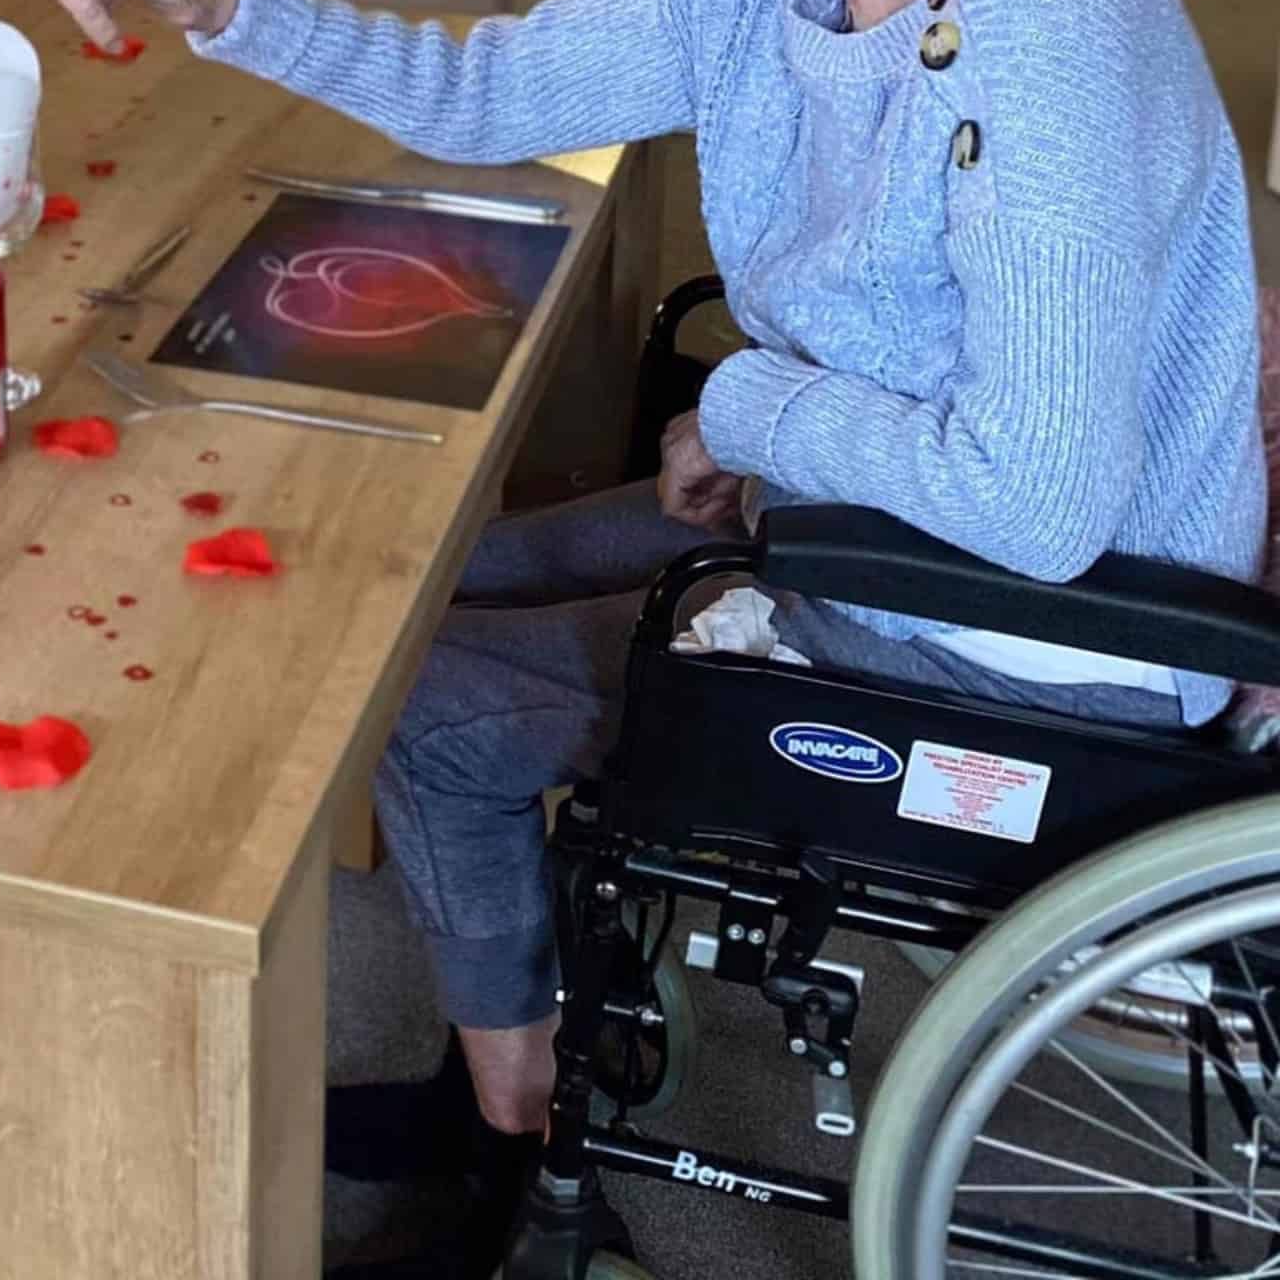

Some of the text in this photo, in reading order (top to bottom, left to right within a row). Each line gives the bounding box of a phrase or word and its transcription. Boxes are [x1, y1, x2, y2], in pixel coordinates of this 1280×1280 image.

[787, 739, 878, 767] INVACARE
[672, 1150, 772, 1202] Ben NG
